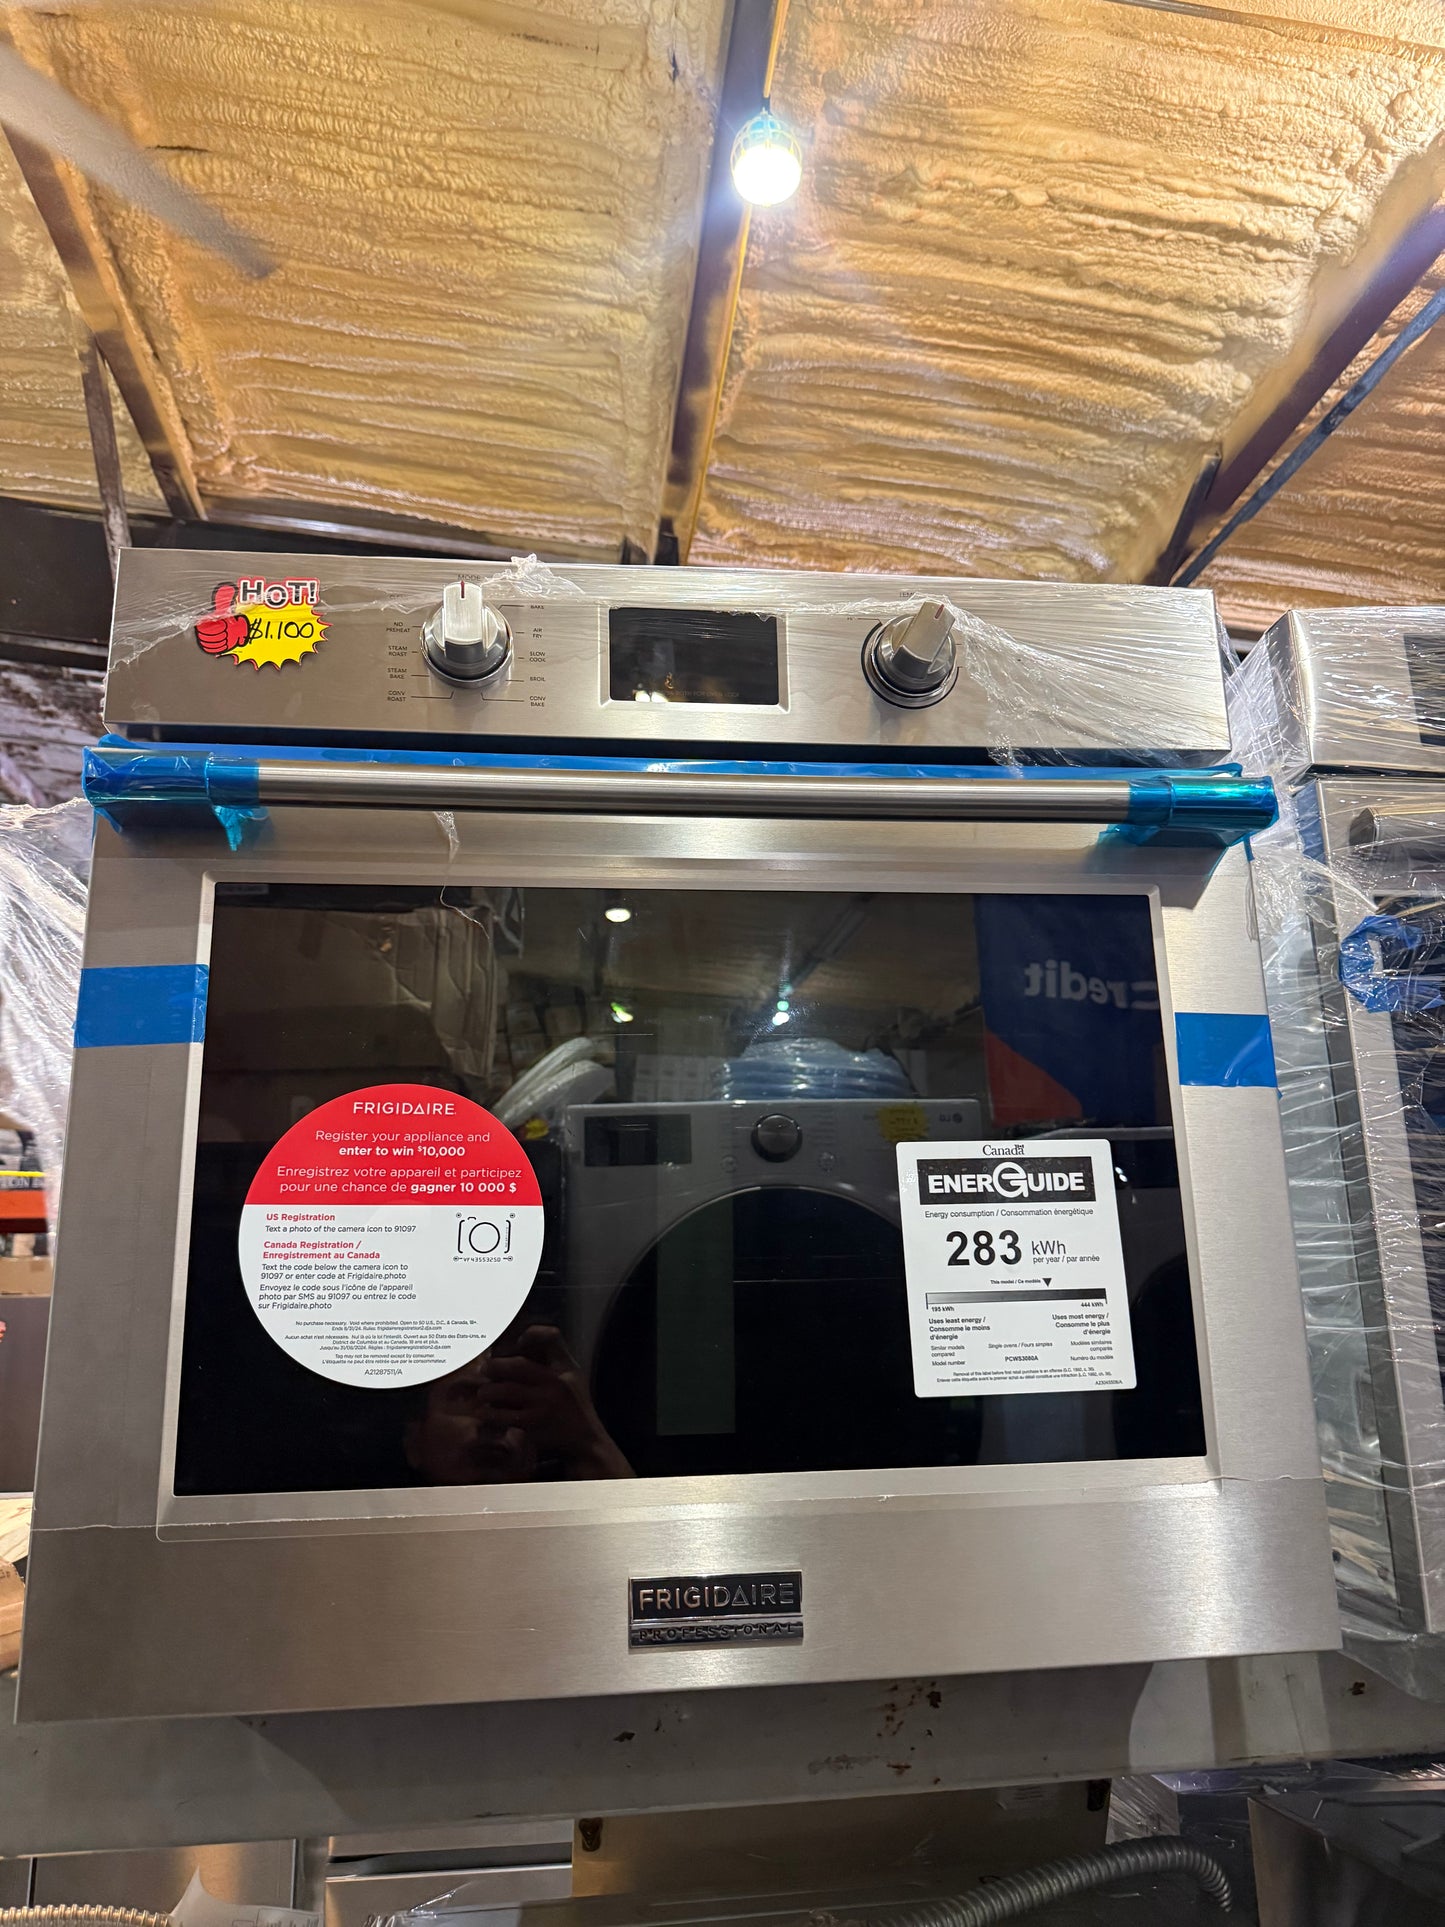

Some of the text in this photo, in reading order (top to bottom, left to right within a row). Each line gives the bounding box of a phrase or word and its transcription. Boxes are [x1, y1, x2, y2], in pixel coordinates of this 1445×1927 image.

[241, 580, 317, 608] HOT!
[353, 1102, 455, 1115] FRIGIDAIRE
[315, 1130, 490, 1143] Register your appliance and
[339, 1146, 465, 1157] enter to win $10,000
[982, 1144, 1025, 1156] Canada
[277, 1166, 522, 1180] Enregistrez votre appareil et participez
[928, 1162, 1085, 1198] ENERGUIDE
[280, 1182, 517, 1194] pour une chance de gagner 10 000 $
[266, 1213, 335, 1222] US Registration
[925, 1207, 1093, 1219] Energy consumption / Consommation énergétique
[289, 1225, 312, 1233] photo
[264, 1240, 362, 1249] Canada Registration /
[946, 1230, 1022, 1266] 283
[1031, 1241, 1066, 1255] kWh
[263, 1252, 331, 1260] Enregistrement
[1045, 1256, 1061, 1264] year
[1079, 1255, 1100, 1263] année
[260, 1284, 291, 1292] Envoyez
[379, 1284, 413, 1292] l'appareil
[259, 1293, 282, 1301] photo
[272, 1302, 332, 1310] Frigidaire.photo
[639, 1583, 794, 1611] FRIGIDAIRE
[639, 1623, 795, 1641] PROFESSIONAL
